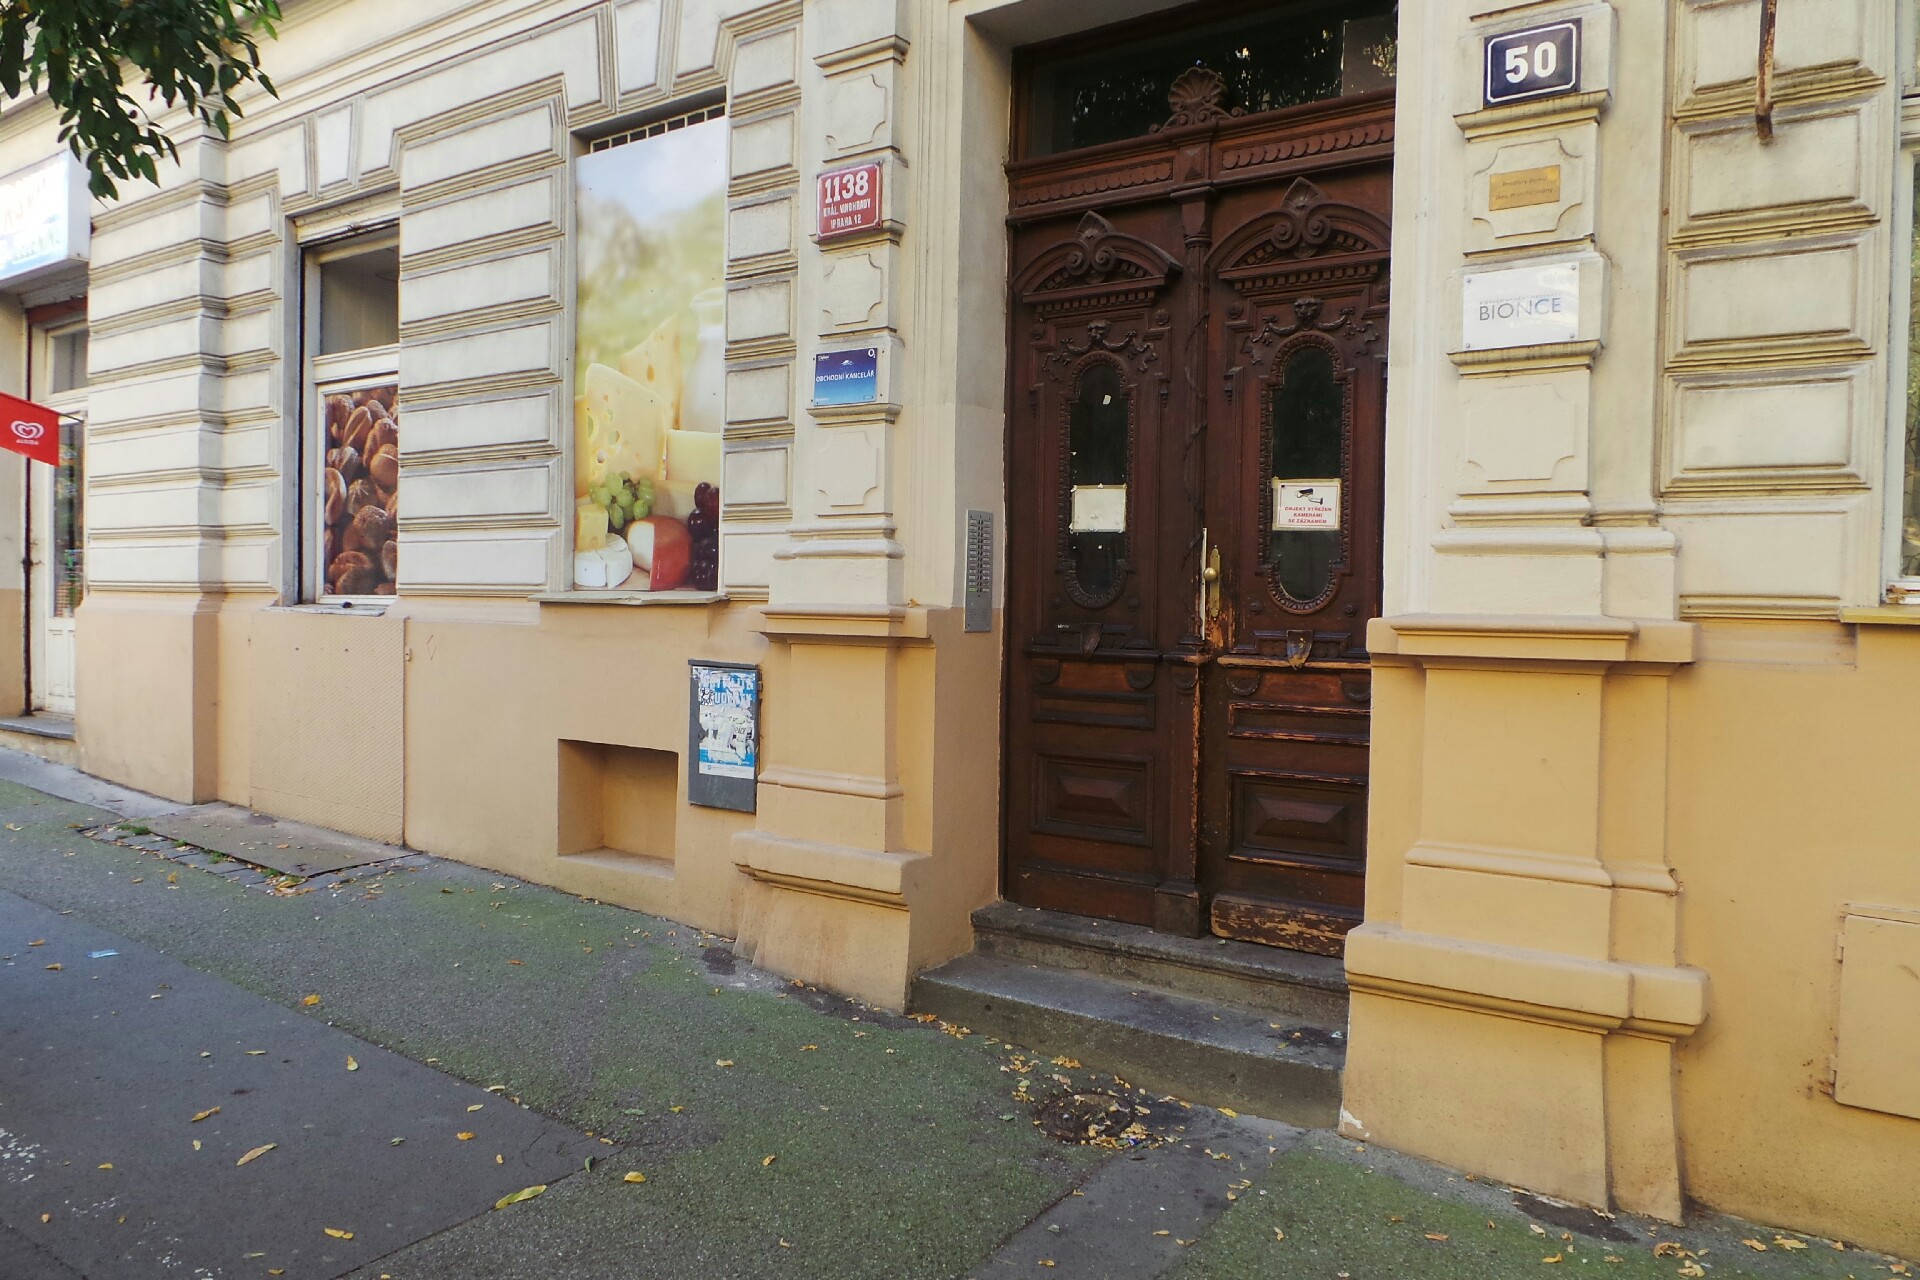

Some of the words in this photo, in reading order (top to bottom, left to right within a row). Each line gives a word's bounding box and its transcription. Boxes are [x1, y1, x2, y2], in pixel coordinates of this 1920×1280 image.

[1505, 41, 1557, 84] 50
[825, 170, 869, 204] 1138
[839, 198, 871, 214] VINOHRADY
[830, 215, 852, 229] PRAHA
[853, 214, 862, 224] 12
[1479, 297, 1561, 321] BIONCE
[815, 372, 845, 383] OBCHODNÍ
[845, 369, 875, 380] KANCELÁŘ
